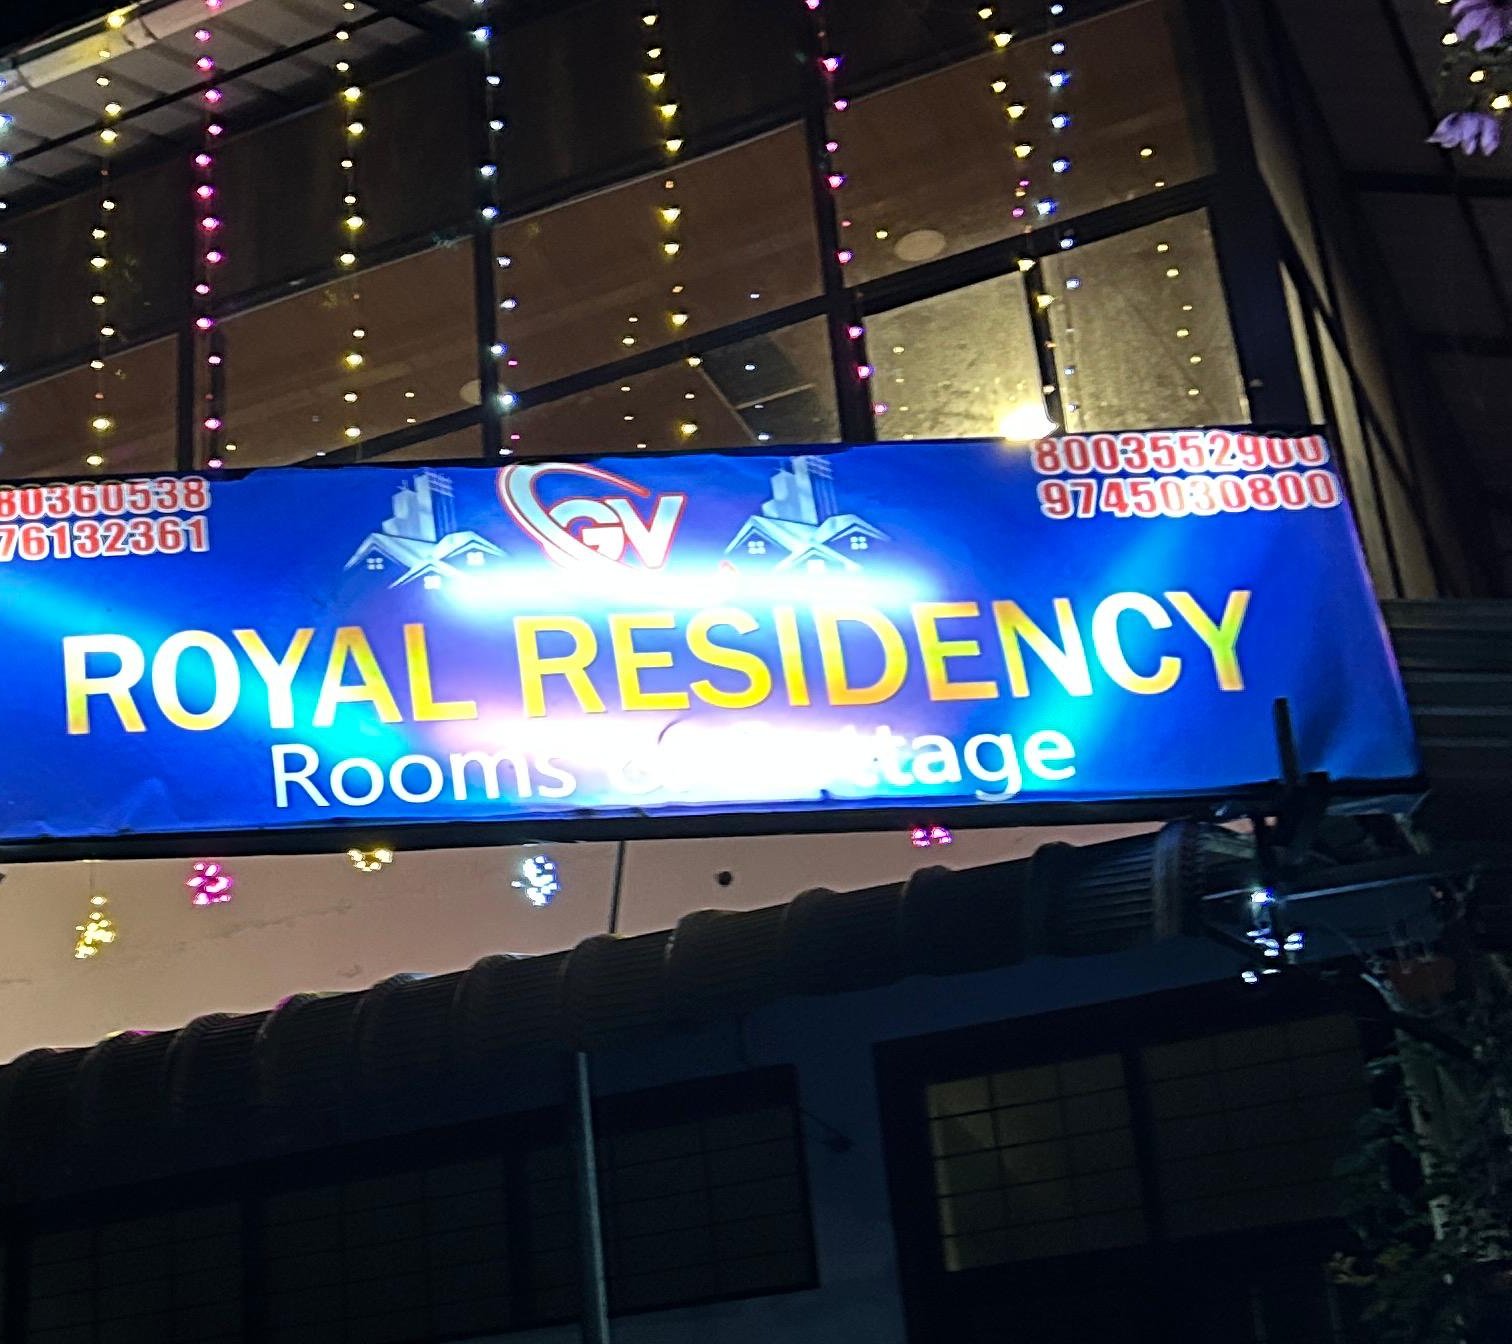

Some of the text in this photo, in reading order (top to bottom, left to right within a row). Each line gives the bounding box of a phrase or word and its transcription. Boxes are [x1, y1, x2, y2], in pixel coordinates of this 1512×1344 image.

[1039, 470, 1341, 519] 9745030800
[62, 590, 1252, 736] ROYAL RESIDENCY
[272, 744, 577, 809] Rooms
